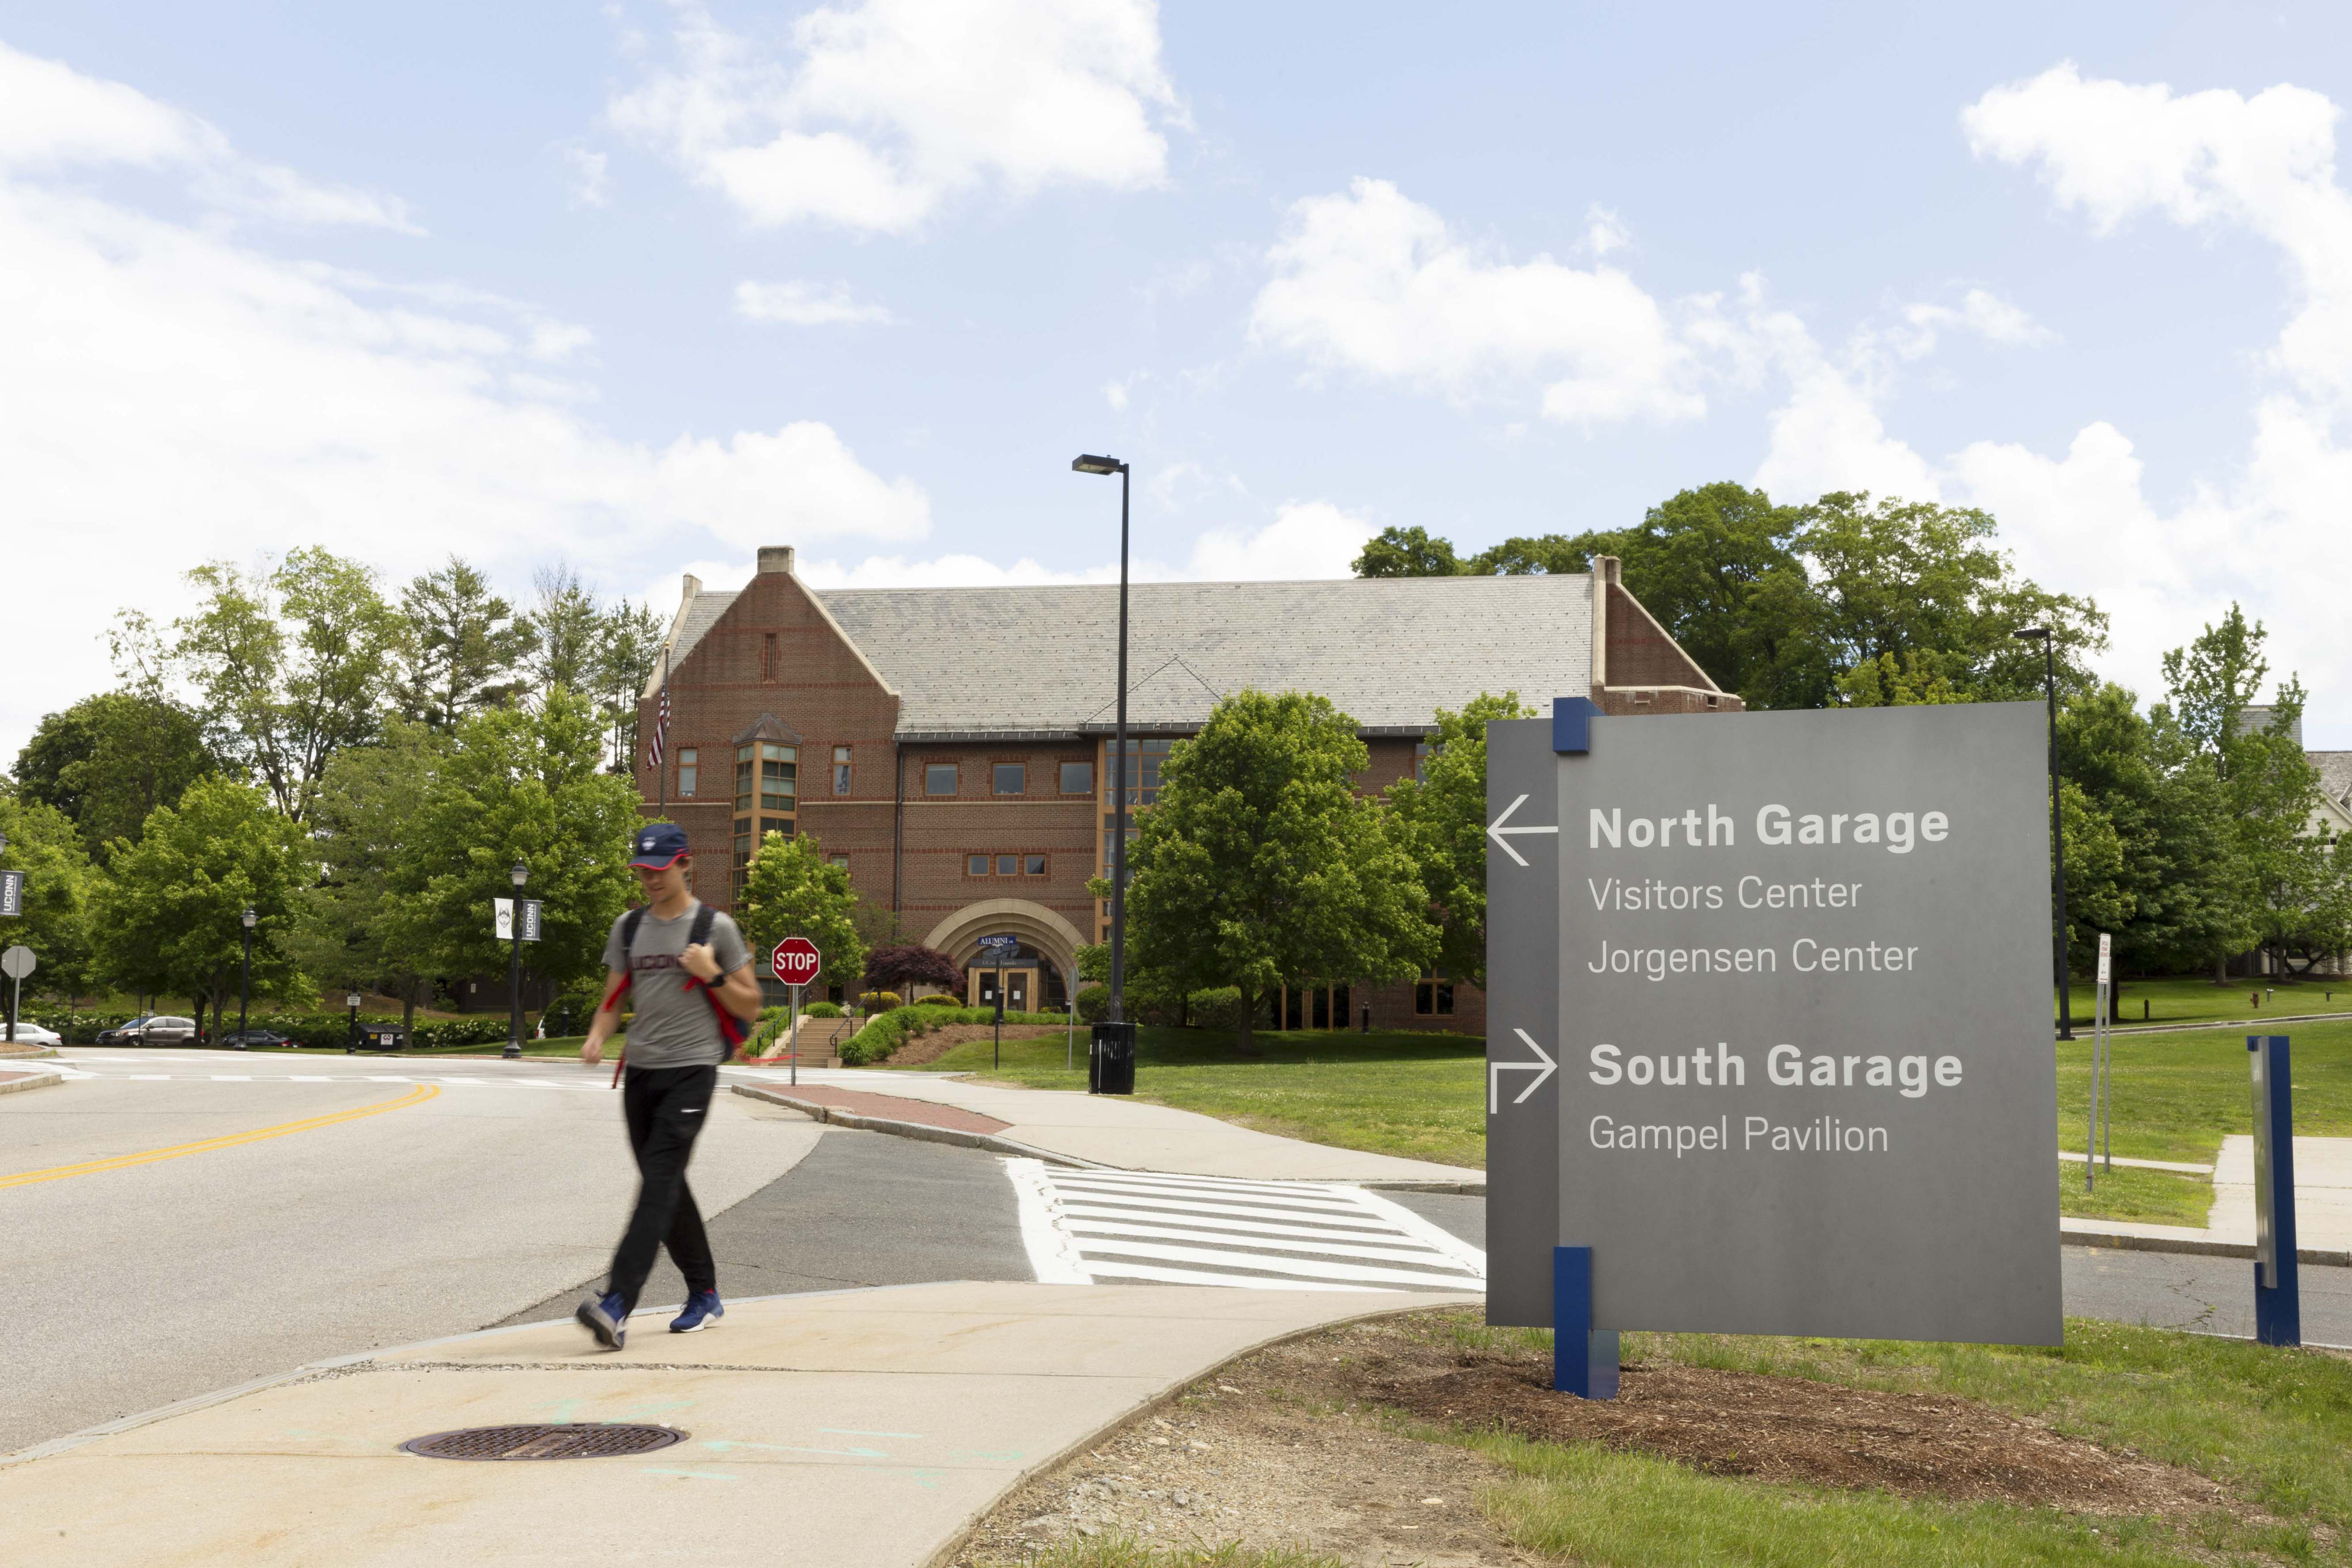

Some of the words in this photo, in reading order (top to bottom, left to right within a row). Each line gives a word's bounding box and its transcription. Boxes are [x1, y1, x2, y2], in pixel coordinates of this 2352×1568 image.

[1589, 803, 1734, 849] North
[1756, 803, 1949, 854] Garage
[3, 875, 15, 911] UCONN
[1588, 878, 1723, 911] Visitors
[1738, 875, 1863, 909] Center
[776, 952, 816, 970] STOP
[1588, 940, 1776, 982] Jorgensen
[1792, 938, 1919, 972] Center
[1588, 1042, 1745, 1086] South
[1767, 1044, 1963, 1098] Garage
[1589, 1115, 1727, 1158] Gampel
[1745, 1115, 1888, 1152] Pavilion
